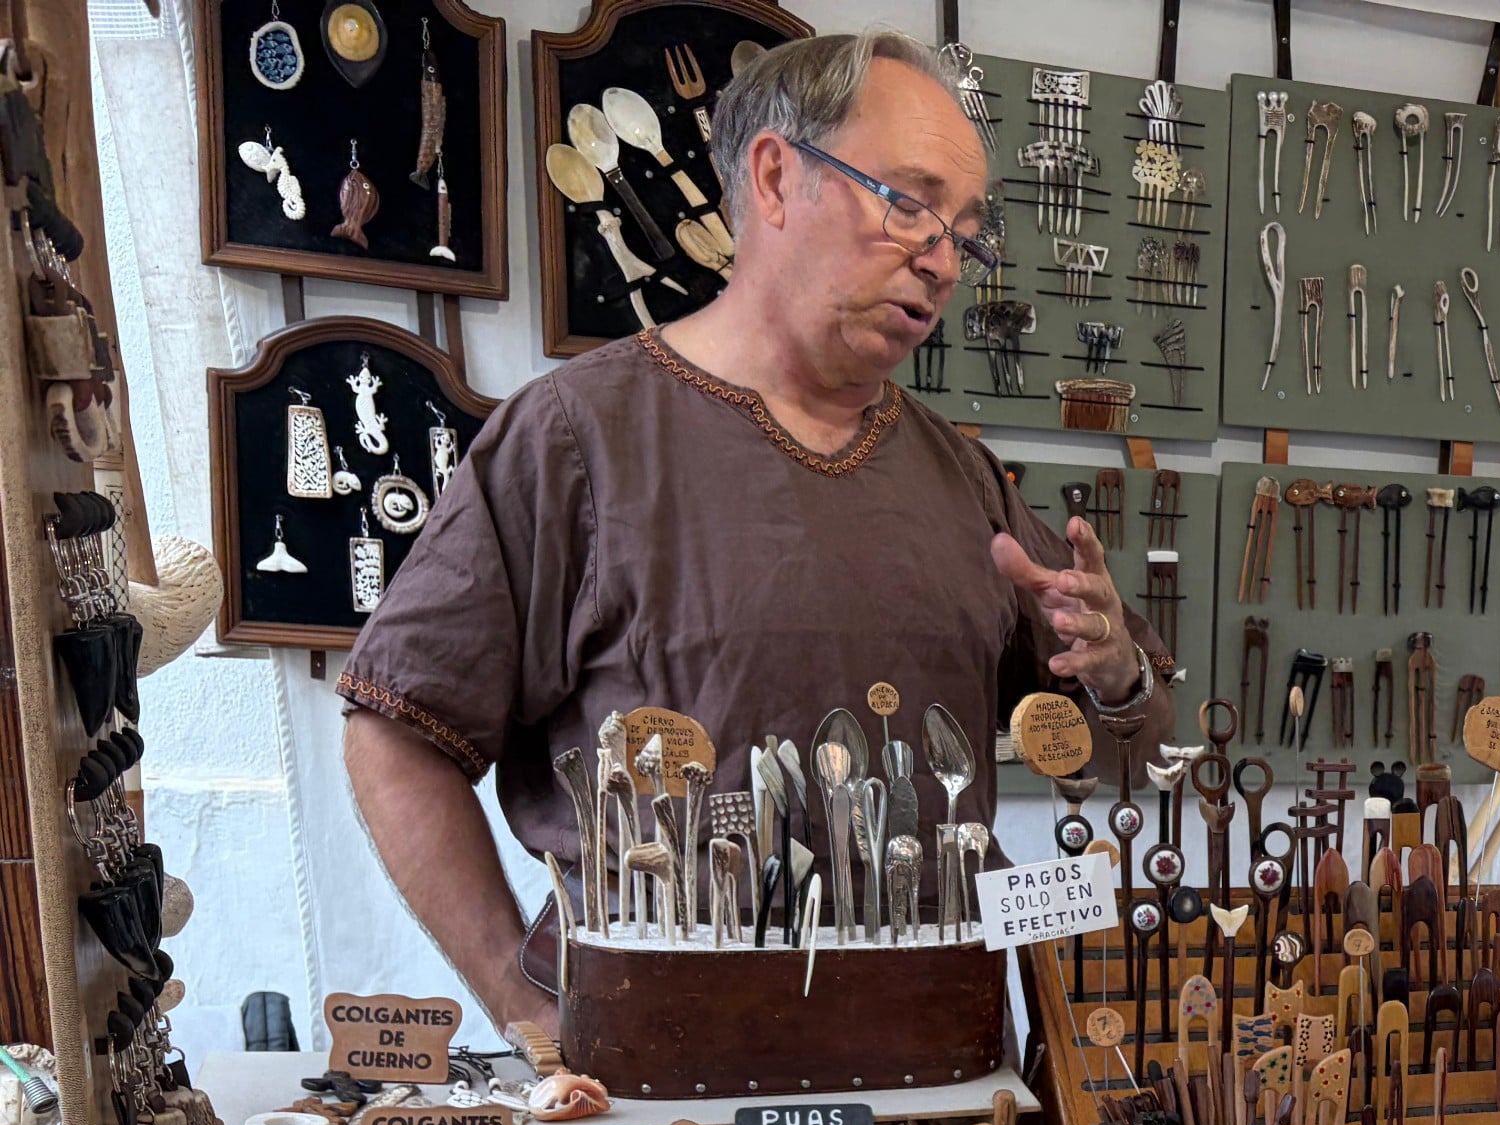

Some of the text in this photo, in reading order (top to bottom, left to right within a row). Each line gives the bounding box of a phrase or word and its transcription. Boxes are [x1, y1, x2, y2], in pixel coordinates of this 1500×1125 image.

[1036, 700, 1069, 711] MADERAS
[643, 715, 674, 726] CIERVO
[1031, 710, 1073, 722] TROPICALES
[667, 738, 694, 746] VACAS
[1042, 741, 1070, 752] RESTOS
[1007, 864, 1081, 891] PAGOS
[1001, 882, 1093, 914] SOLO EN
[1004, 905, 1102, 936] EFECTIVO
[332, 1006, 453, 1026] COLGANTES
[379, 1030, 404, 1047] DE
[348, 1051, 431, 1070] CUERNO
